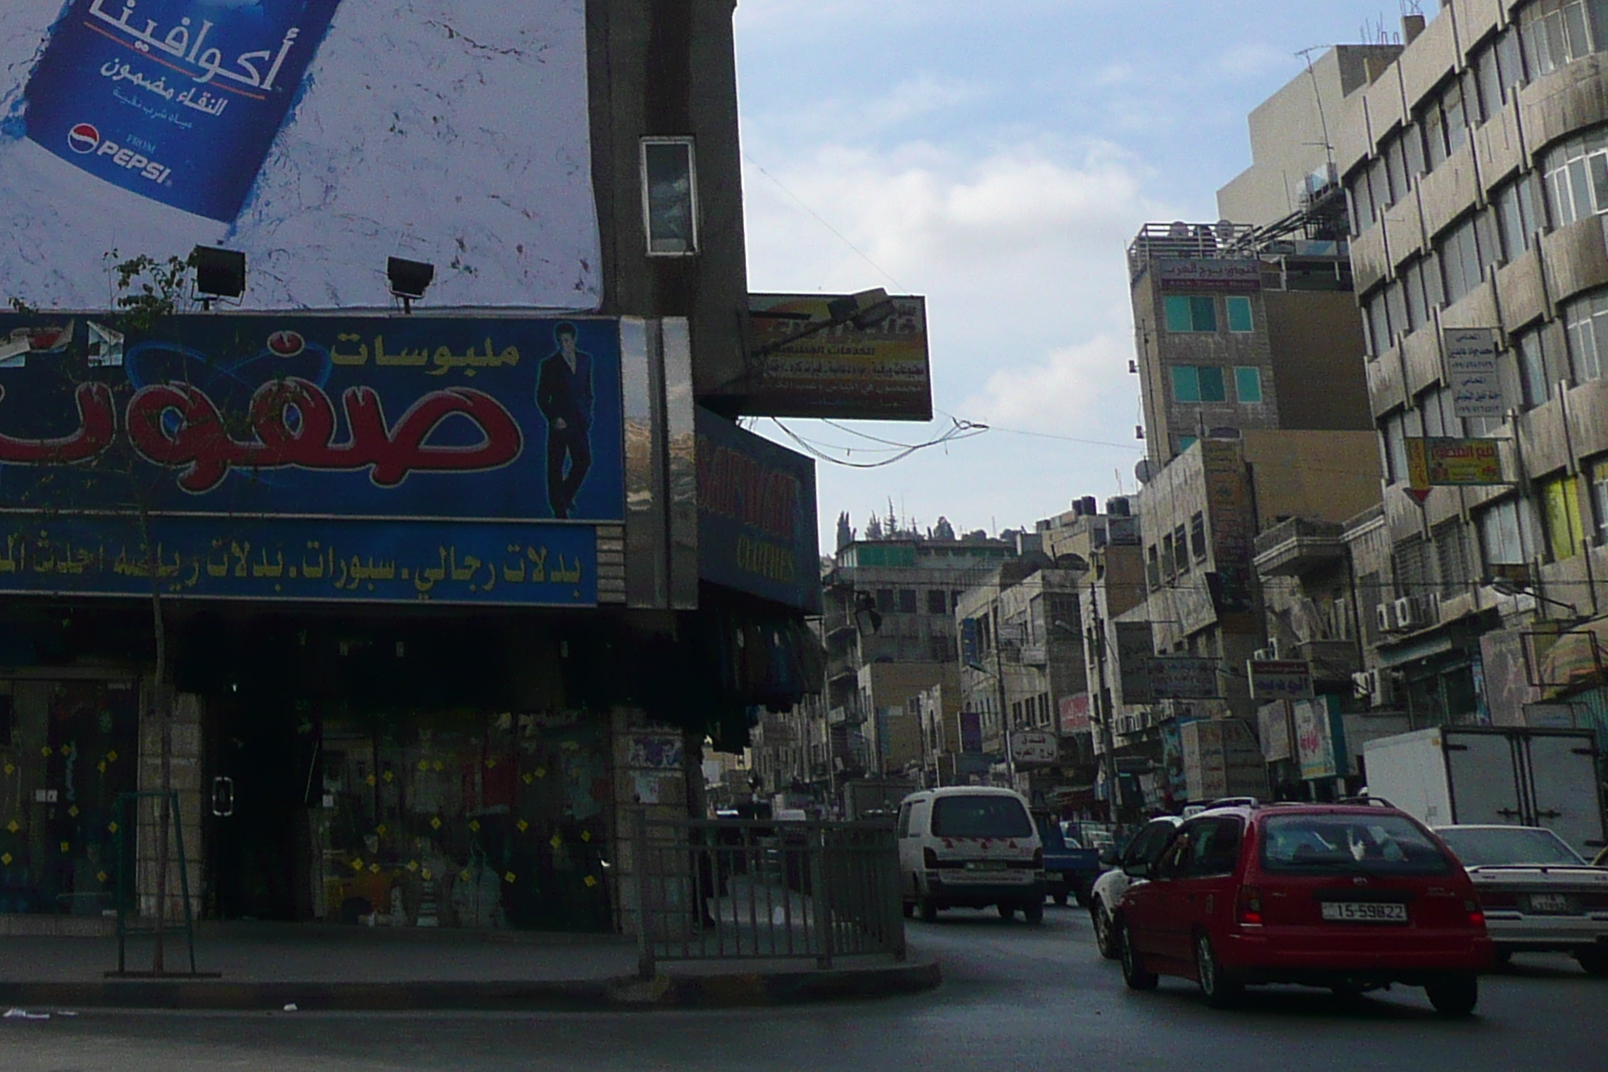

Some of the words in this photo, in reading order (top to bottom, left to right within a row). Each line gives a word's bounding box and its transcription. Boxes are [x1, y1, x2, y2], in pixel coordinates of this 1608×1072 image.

[100, 57, 174, 100] مضمون
[176, 87, 228, 116] النقاء
[97, 140, 172, 184] PEPSI
[126, 134, 157, 154] FROM
[330, 333, 520, 377] ملبوسات
[207, 537, 285, 592] بدلات
[414, 545, 497, 601] رجالي
[504, 542, 583, 598] بدلات
